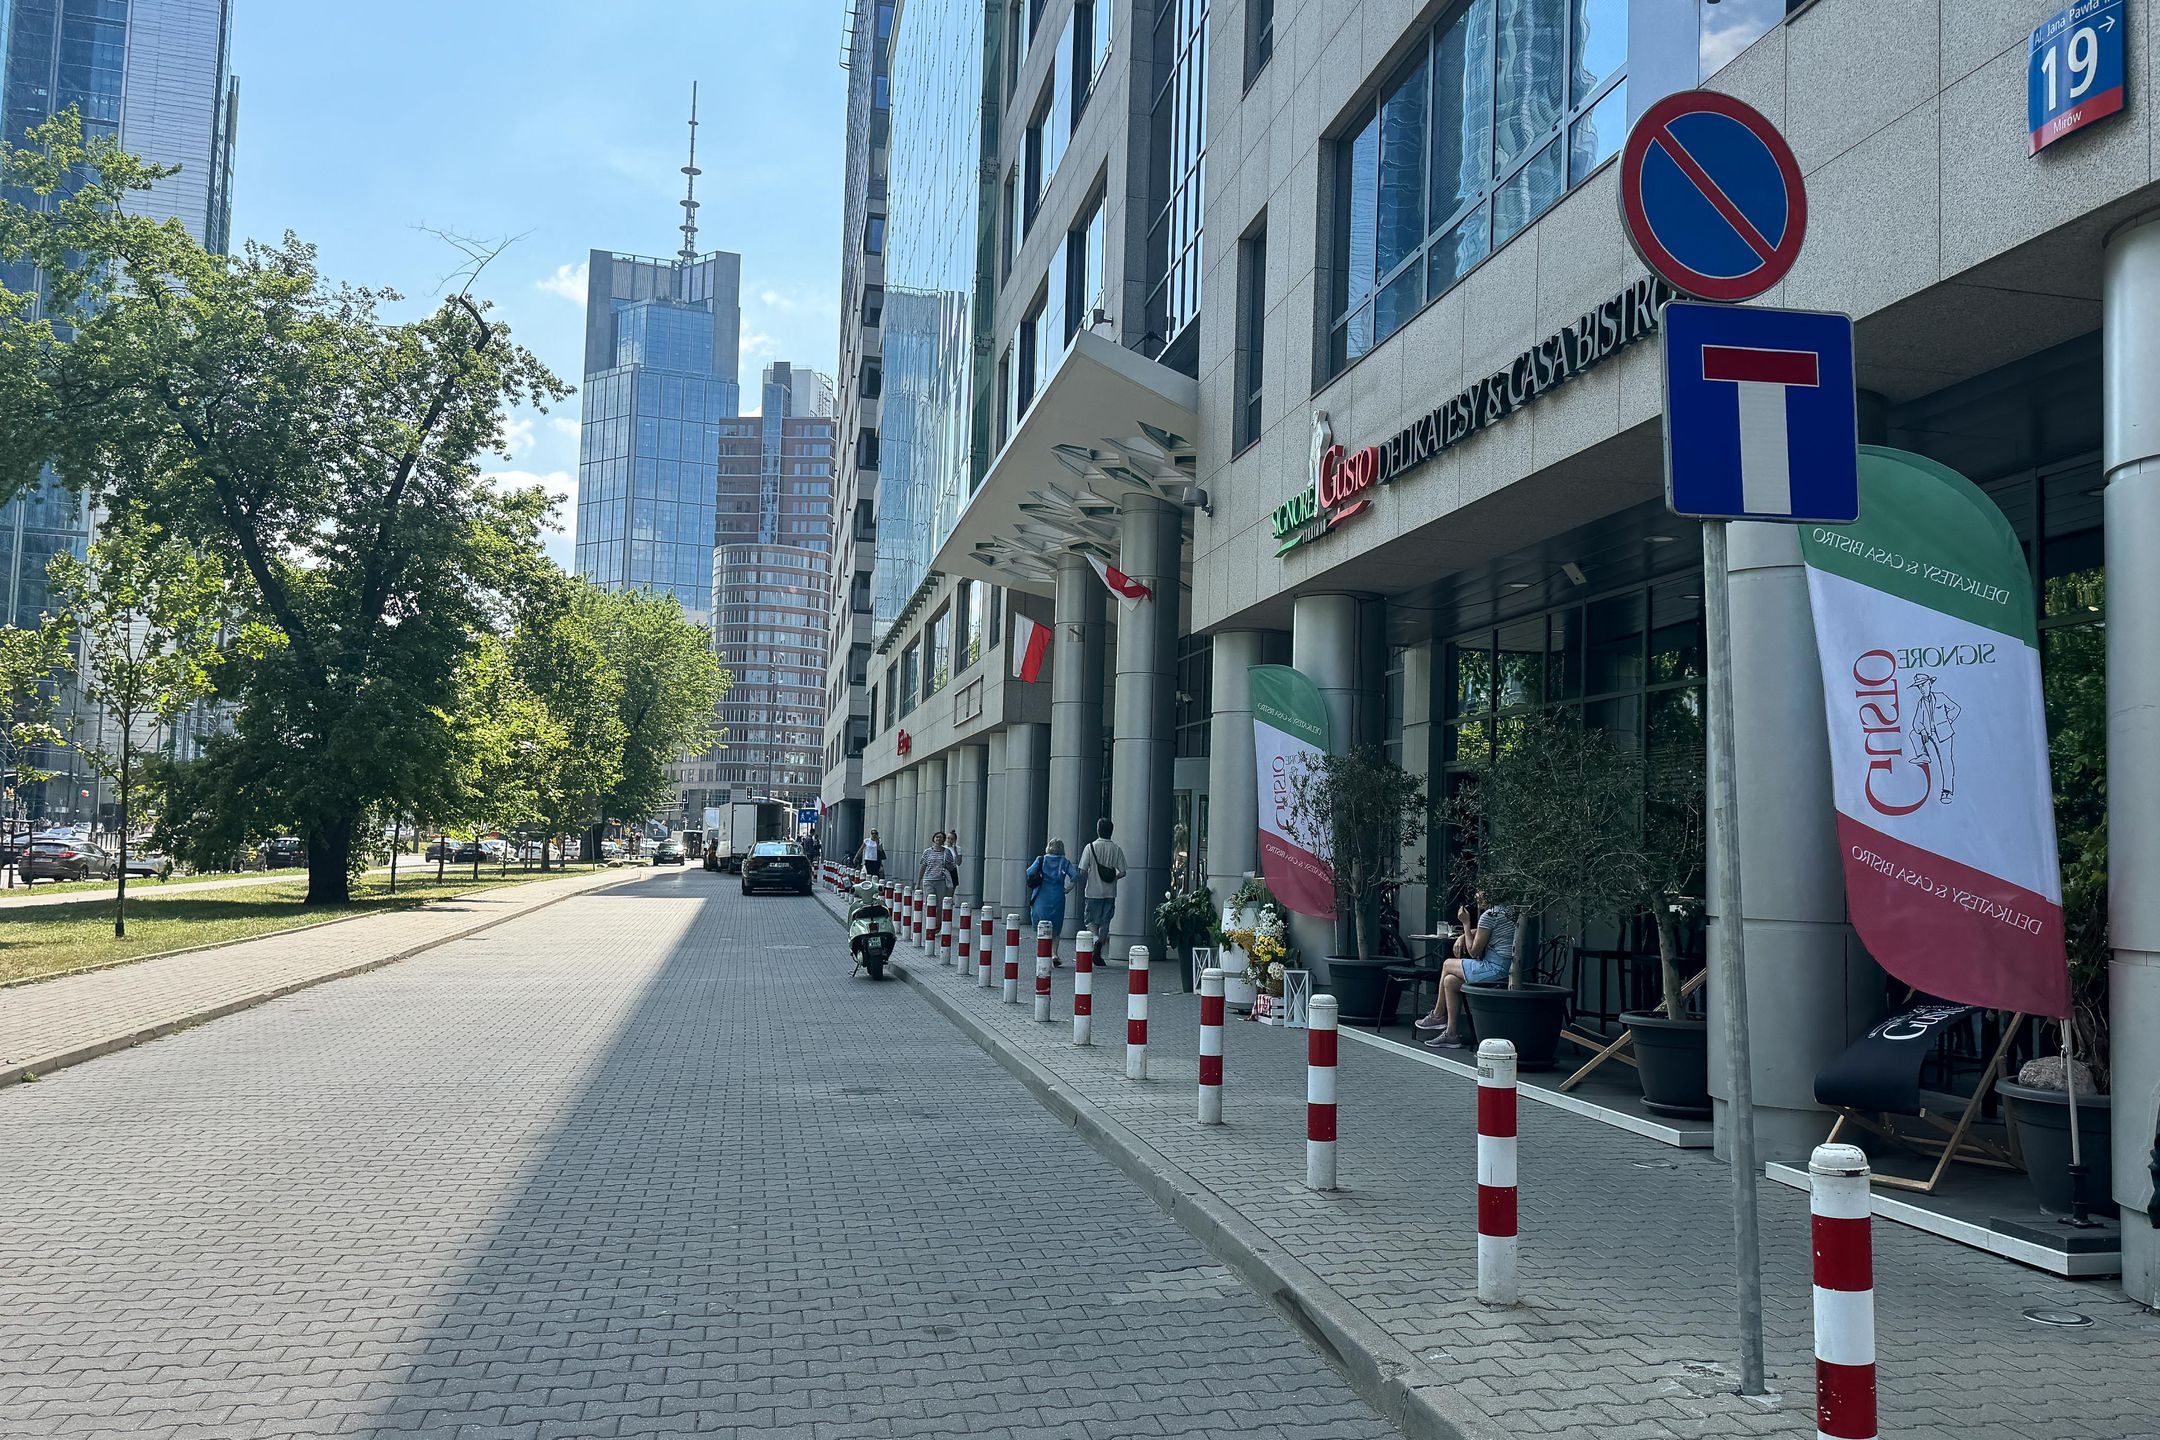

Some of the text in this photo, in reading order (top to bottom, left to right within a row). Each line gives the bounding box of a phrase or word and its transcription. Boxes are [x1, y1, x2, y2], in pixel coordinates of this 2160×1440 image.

[2034, 29, 2044, 47] Al.
[2047, 17, 2066, 37] Jana
[2041, 27, 2098, 112] 19
[2053, 111, 2082, 134] Mirów
[1271, 487, 1315, 537] SIGNORE
[1377, 379, 1484, 485] DELIKATESY
[1486, 373, 1504, 419] &
[1508, 328, 1572, 406] CASA
